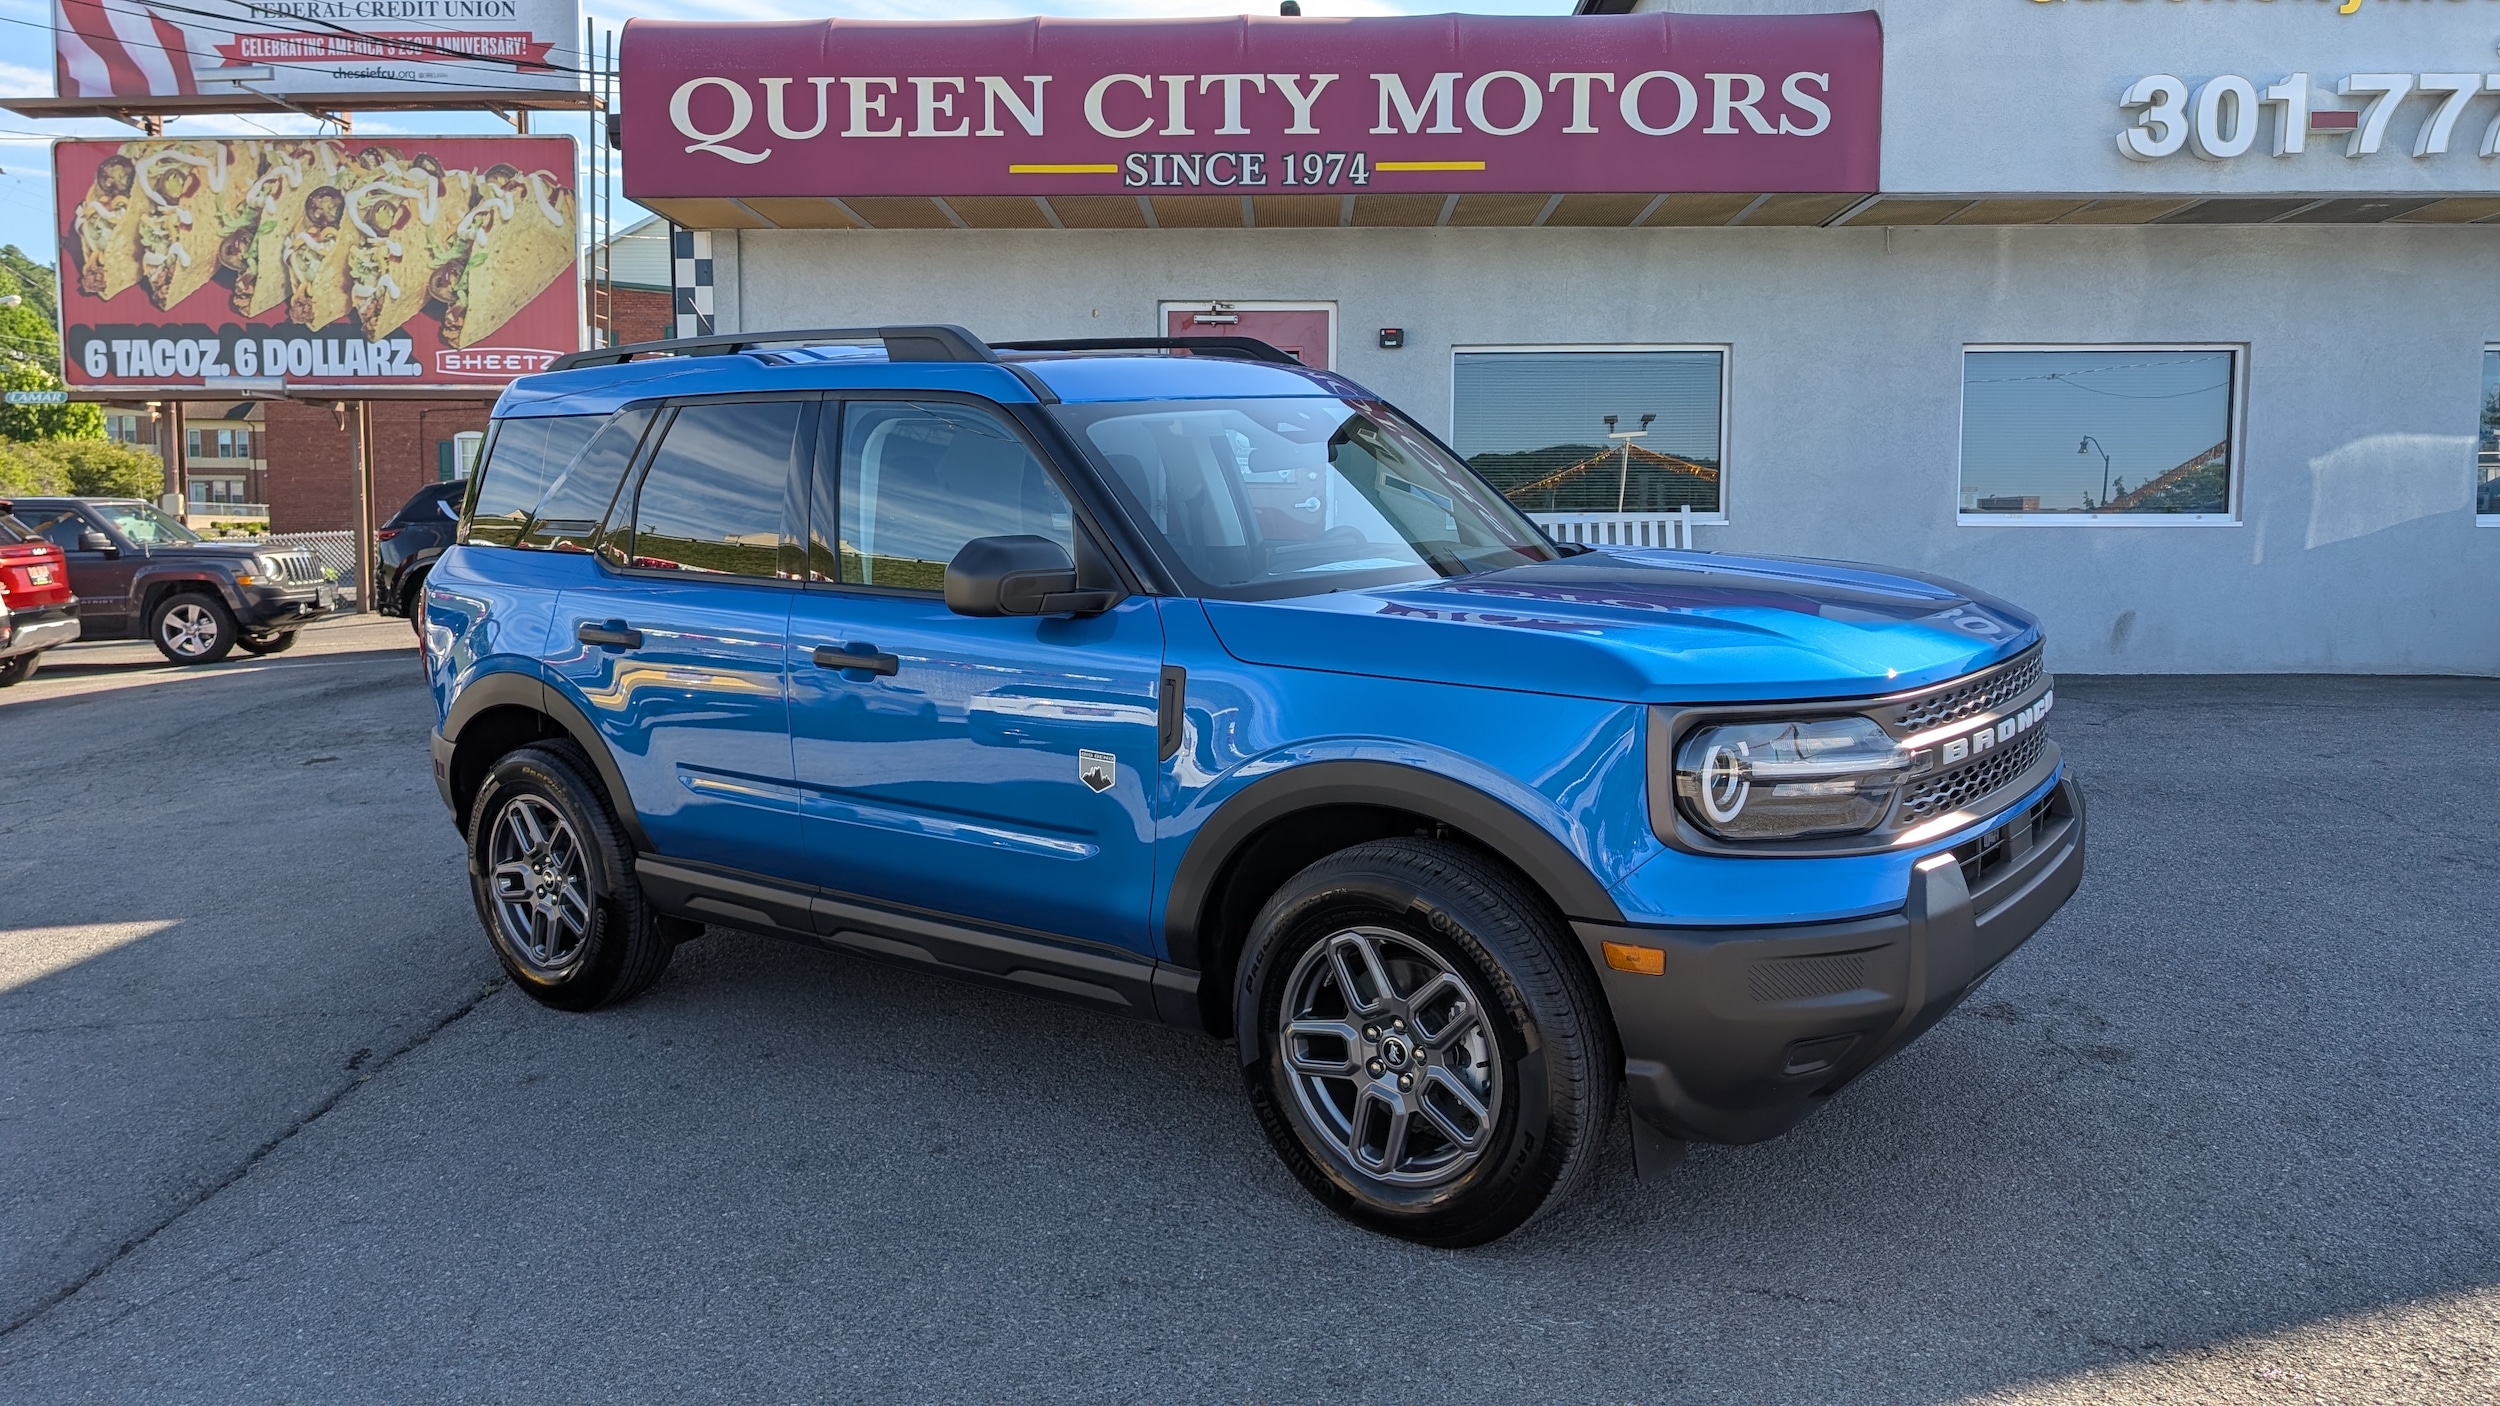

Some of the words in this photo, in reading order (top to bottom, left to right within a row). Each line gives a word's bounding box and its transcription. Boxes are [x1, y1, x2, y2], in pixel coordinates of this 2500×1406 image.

[249, 1, 351, 18] FEDERAL
[356, 0, 439, 17] CREDIT
[446, 0, 516, 17] UNION
[241, 38, 325, 57] CELEBRATING
[328, 37, 396, 55] AMERICAS
[435, 36, 527, 55] ANNIVERSARY!
[332, 67, 416, 80] chessiefcu.org
[668, 75, 1053, 164] QUEEN
[1083, 73, 1339, 138] CITY
[1369, 70, 1831, 137] MOTORS
[2115, 72, 2500, 161] 301-77
[1124, 152, 1267, 187] SINCE
[1281, 151, 1370, 187] 1974
[84, 339, 108, 378] 6
[111, 339, 230, 377] TACOZ.
[234, 338, 258, 377] 6
[262, 338, 423, 377] DOLLARZ.
[445, 354, 555, 370] SHEETZ
[10, 392, 62, 402] LAMAR
[1942, 689, 2054, 765] BRONCO
